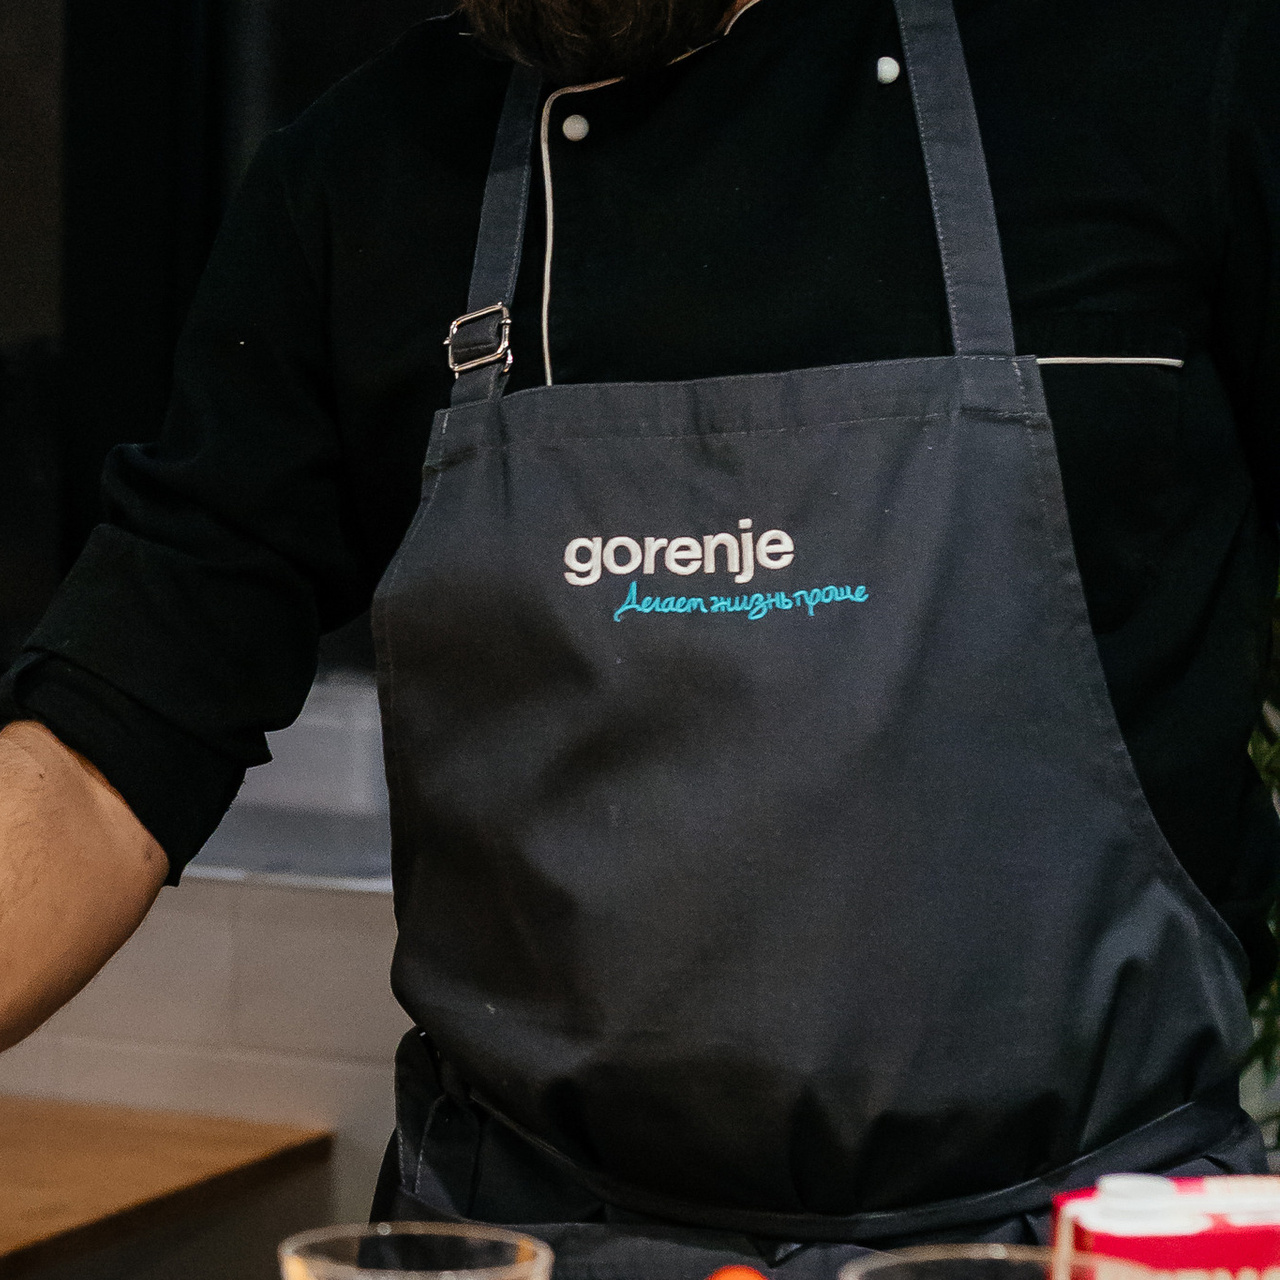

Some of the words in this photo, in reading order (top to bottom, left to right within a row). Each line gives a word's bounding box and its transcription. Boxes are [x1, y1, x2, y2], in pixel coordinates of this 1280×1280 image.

[564, 518, 795, 587] gorenje
[613, 580, 709, 622] Делает
[709, 592, 793, 621] жизнь
